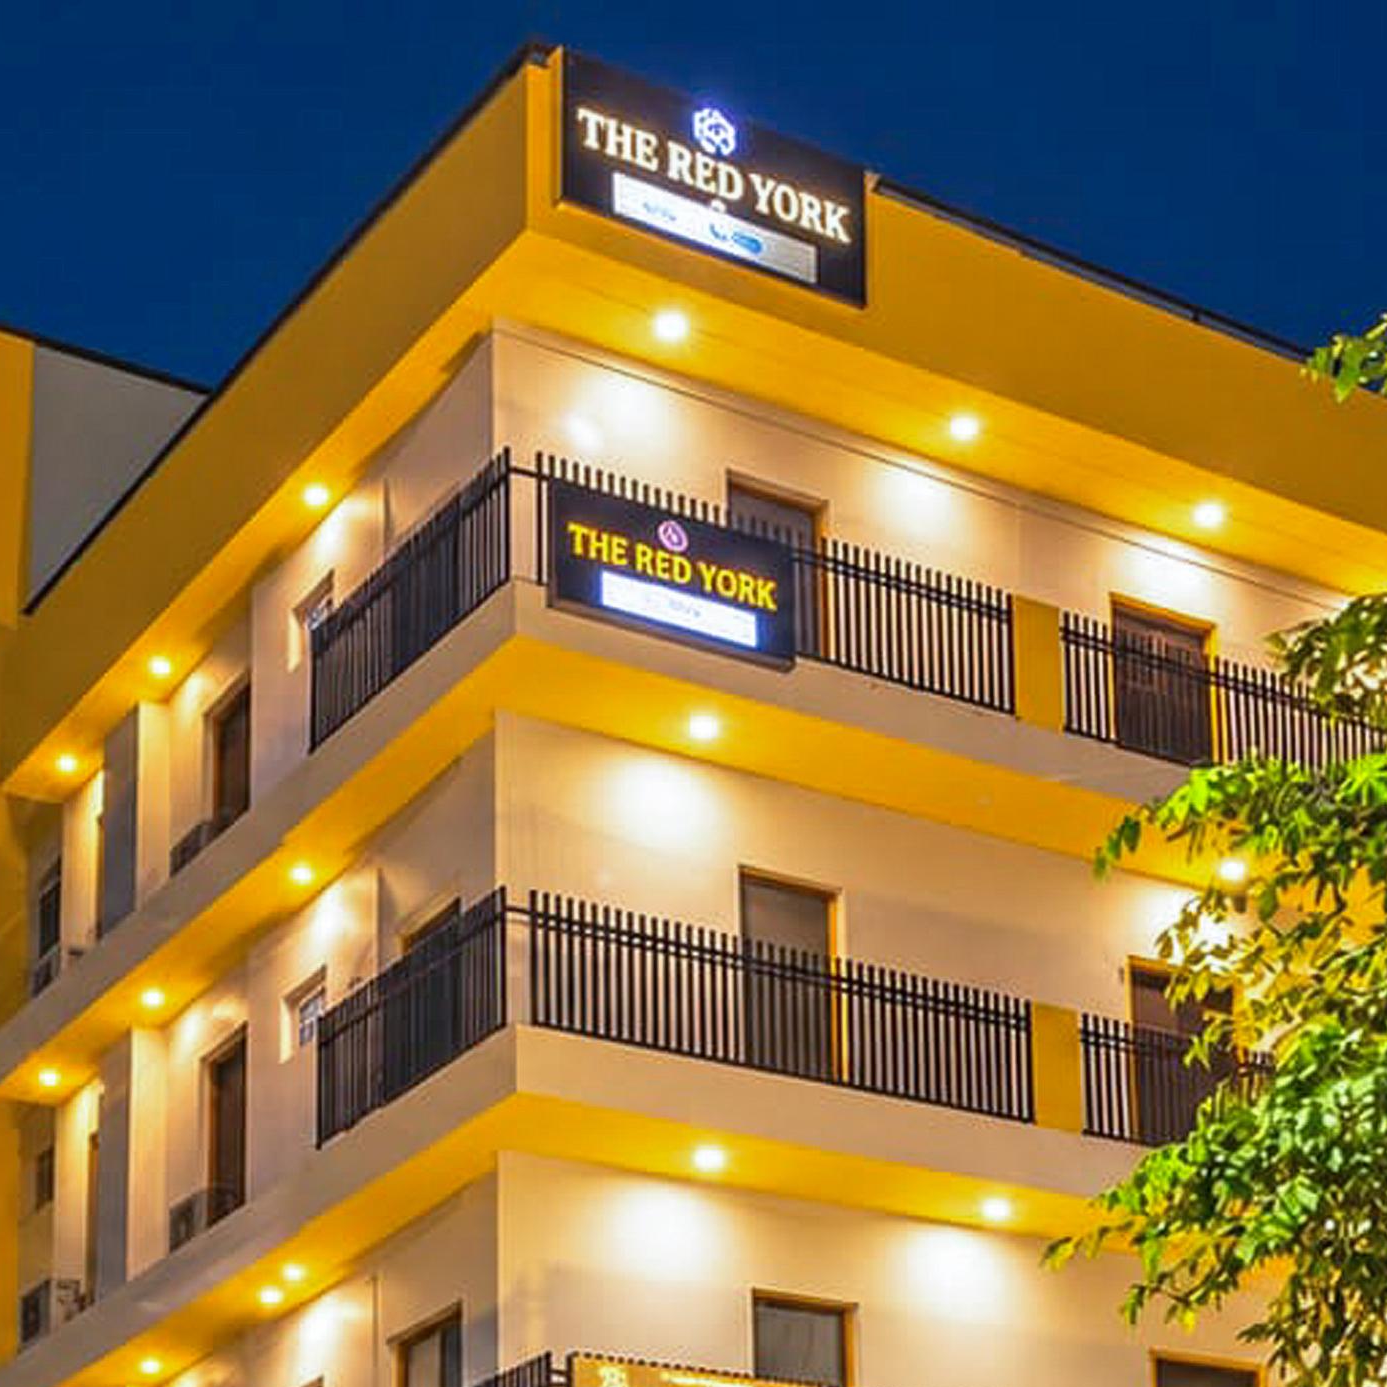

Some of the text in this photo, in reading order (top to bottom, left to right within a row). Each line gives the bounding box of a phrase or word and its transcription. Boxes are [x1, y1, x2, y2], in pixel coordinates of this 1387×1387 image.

[576, 108, 660, 171] THE
[668, 140, 744, 202] RED
[748, 172, 853, 244] YORK
[566, 521, 629, 567] THE
[634, 544, 692, 585] RED
[697, 561, 778, 613] YORK
